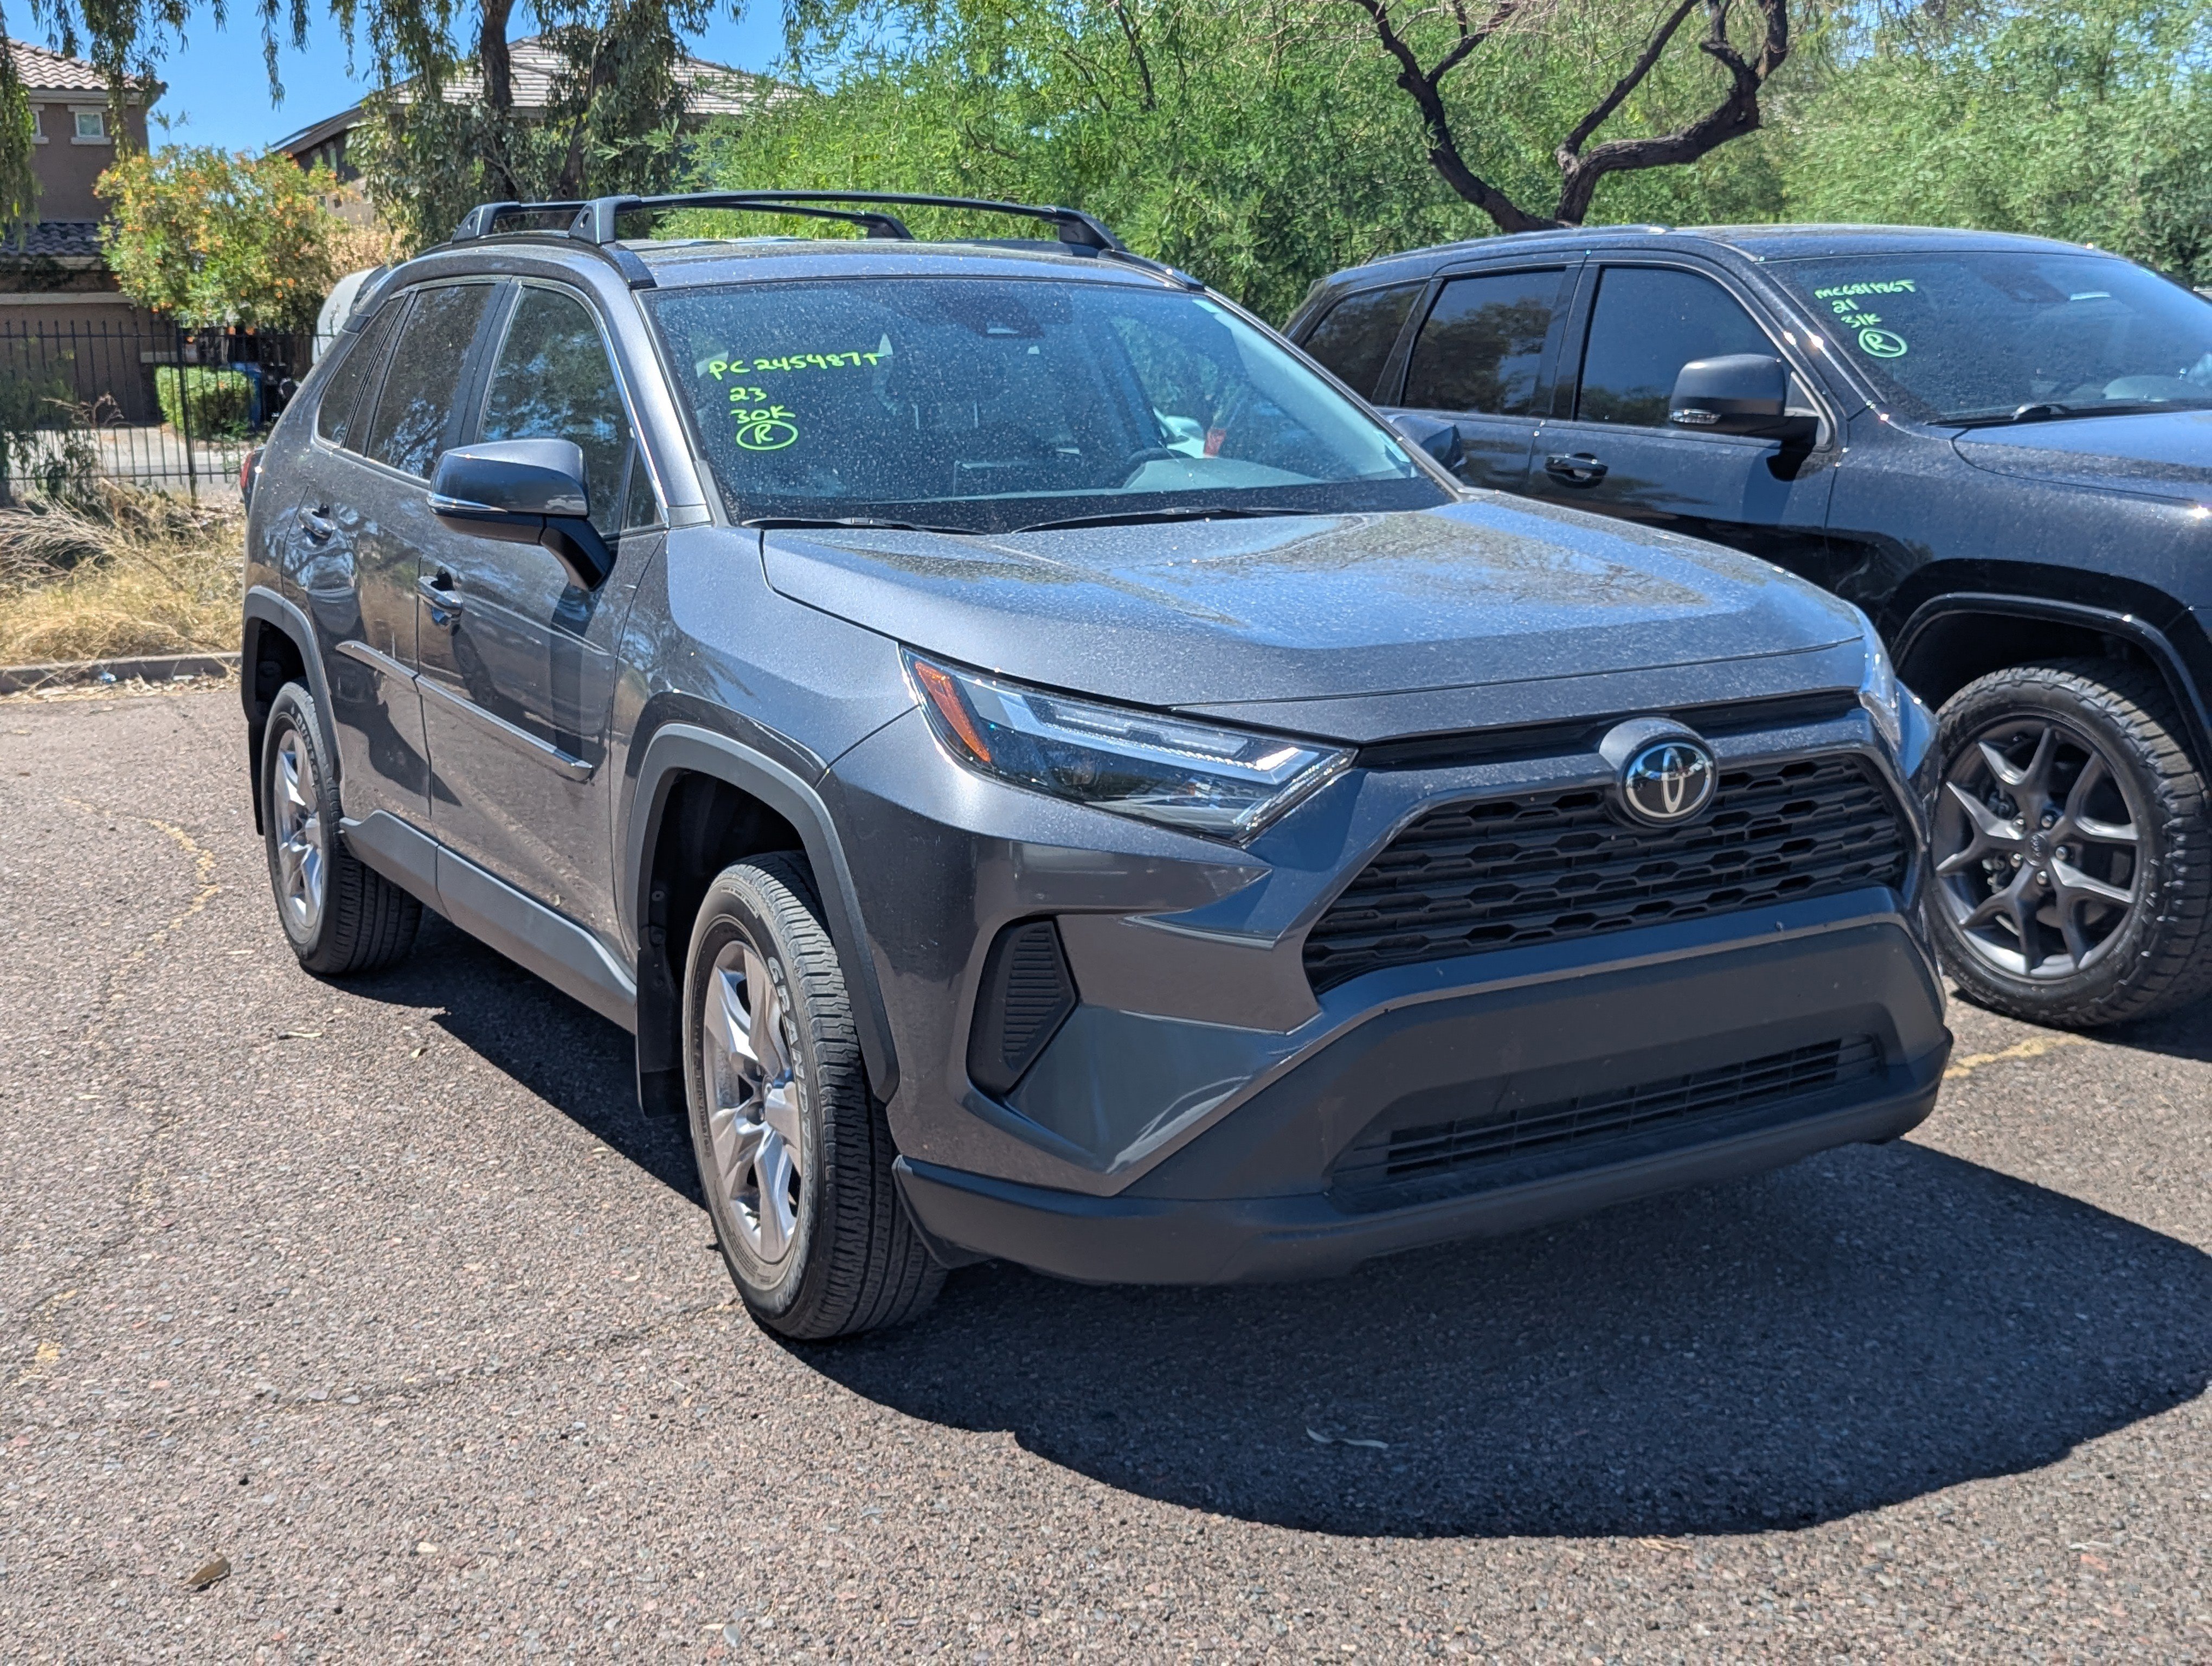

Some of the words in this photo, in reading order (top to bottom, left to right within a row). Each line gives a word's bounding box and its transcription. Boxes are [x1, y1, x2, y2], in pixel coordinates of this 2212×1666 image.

[1831, 298, 1860, 314] 21
[1840, 312, 1882, 329] 31K
[709, 360, 751, 380] PC
[730, 387, 767, 402] 23
[731, 405, 796, 424] 30K
